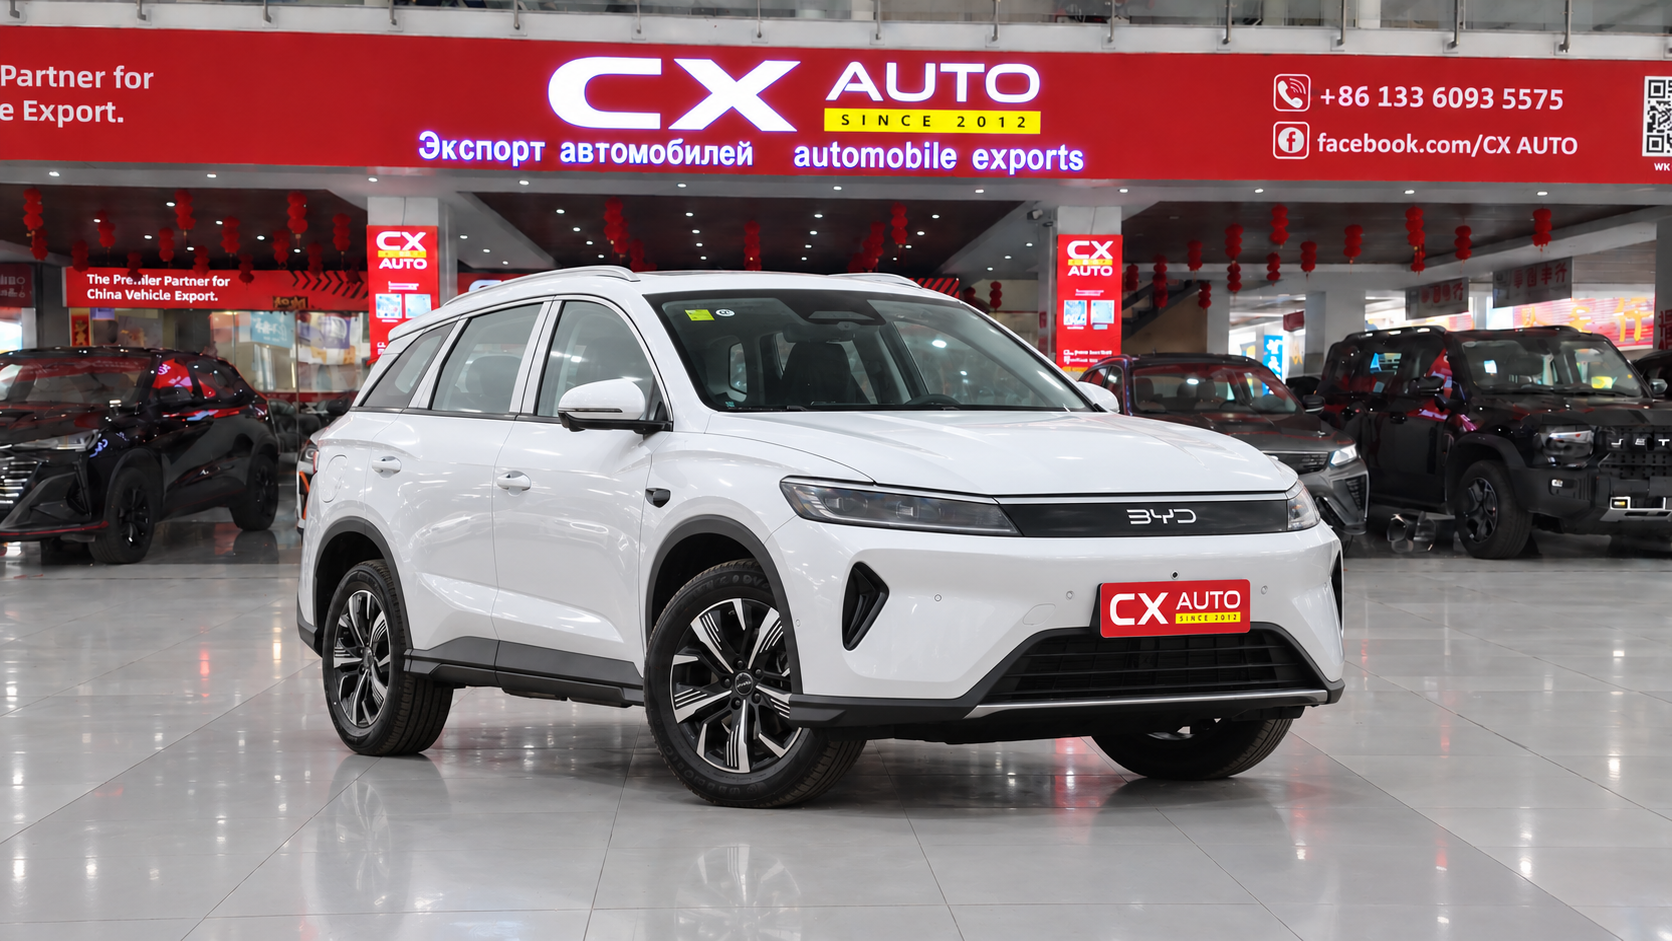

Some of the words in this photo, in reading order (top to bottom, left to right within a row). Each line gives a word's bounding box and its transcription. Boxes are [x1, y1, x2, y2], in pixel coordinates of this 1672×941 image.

[1, 65, 105, 88] Partner
[114, 66, 153, 89] for
[548, 57, 800, 131] CX
[826, 62, 1040, 103] AUTO
[1321, 86, 1369, 106] +86
[1378, 86, 1423, 107] 133
[1433, 87, 1493, 108] 6093
[1503, 89, 1563, 110] 5575
[24, 100, 123, 127] Export.
[841, 113, 932, 128] SINCE
[956, 114, 1027, 129] 2012
[419, 131, 545, 166] Экспорт
[561, 139, 752, 165] автомобилей
[1317, 133, 1510, 157] facebook.com/CX
[1517, 137, 1577, 154] AUTO
[794, 142, 956, 169] automobile
[973, 145, 1083, 175] exports
[376, 231, 427, 251] CX
[1067, 240, 1114, 260] CX
[379, 258, 428, 269] AUTO
[1067, 265, 1113, 276] AUTO
[87, 274, 110, 285] The
[113, 274, 162, 286] Preier
[164, 275, 210, 287] Partner
[212, 275, 231, 287] for
[87, 288, 122, 300] China
[125, 289, 171, 301] Vehicle
[175, 290, 218, 303] Export.
[1127, 509, 1196, 524] BYD
[1110, 593, 1168, 625] CX
[1176, 591, 1240, 610] AUTO
[1179, 614, 1208, 622] SINCE
[1215, 613, 1237, 621] 2012
